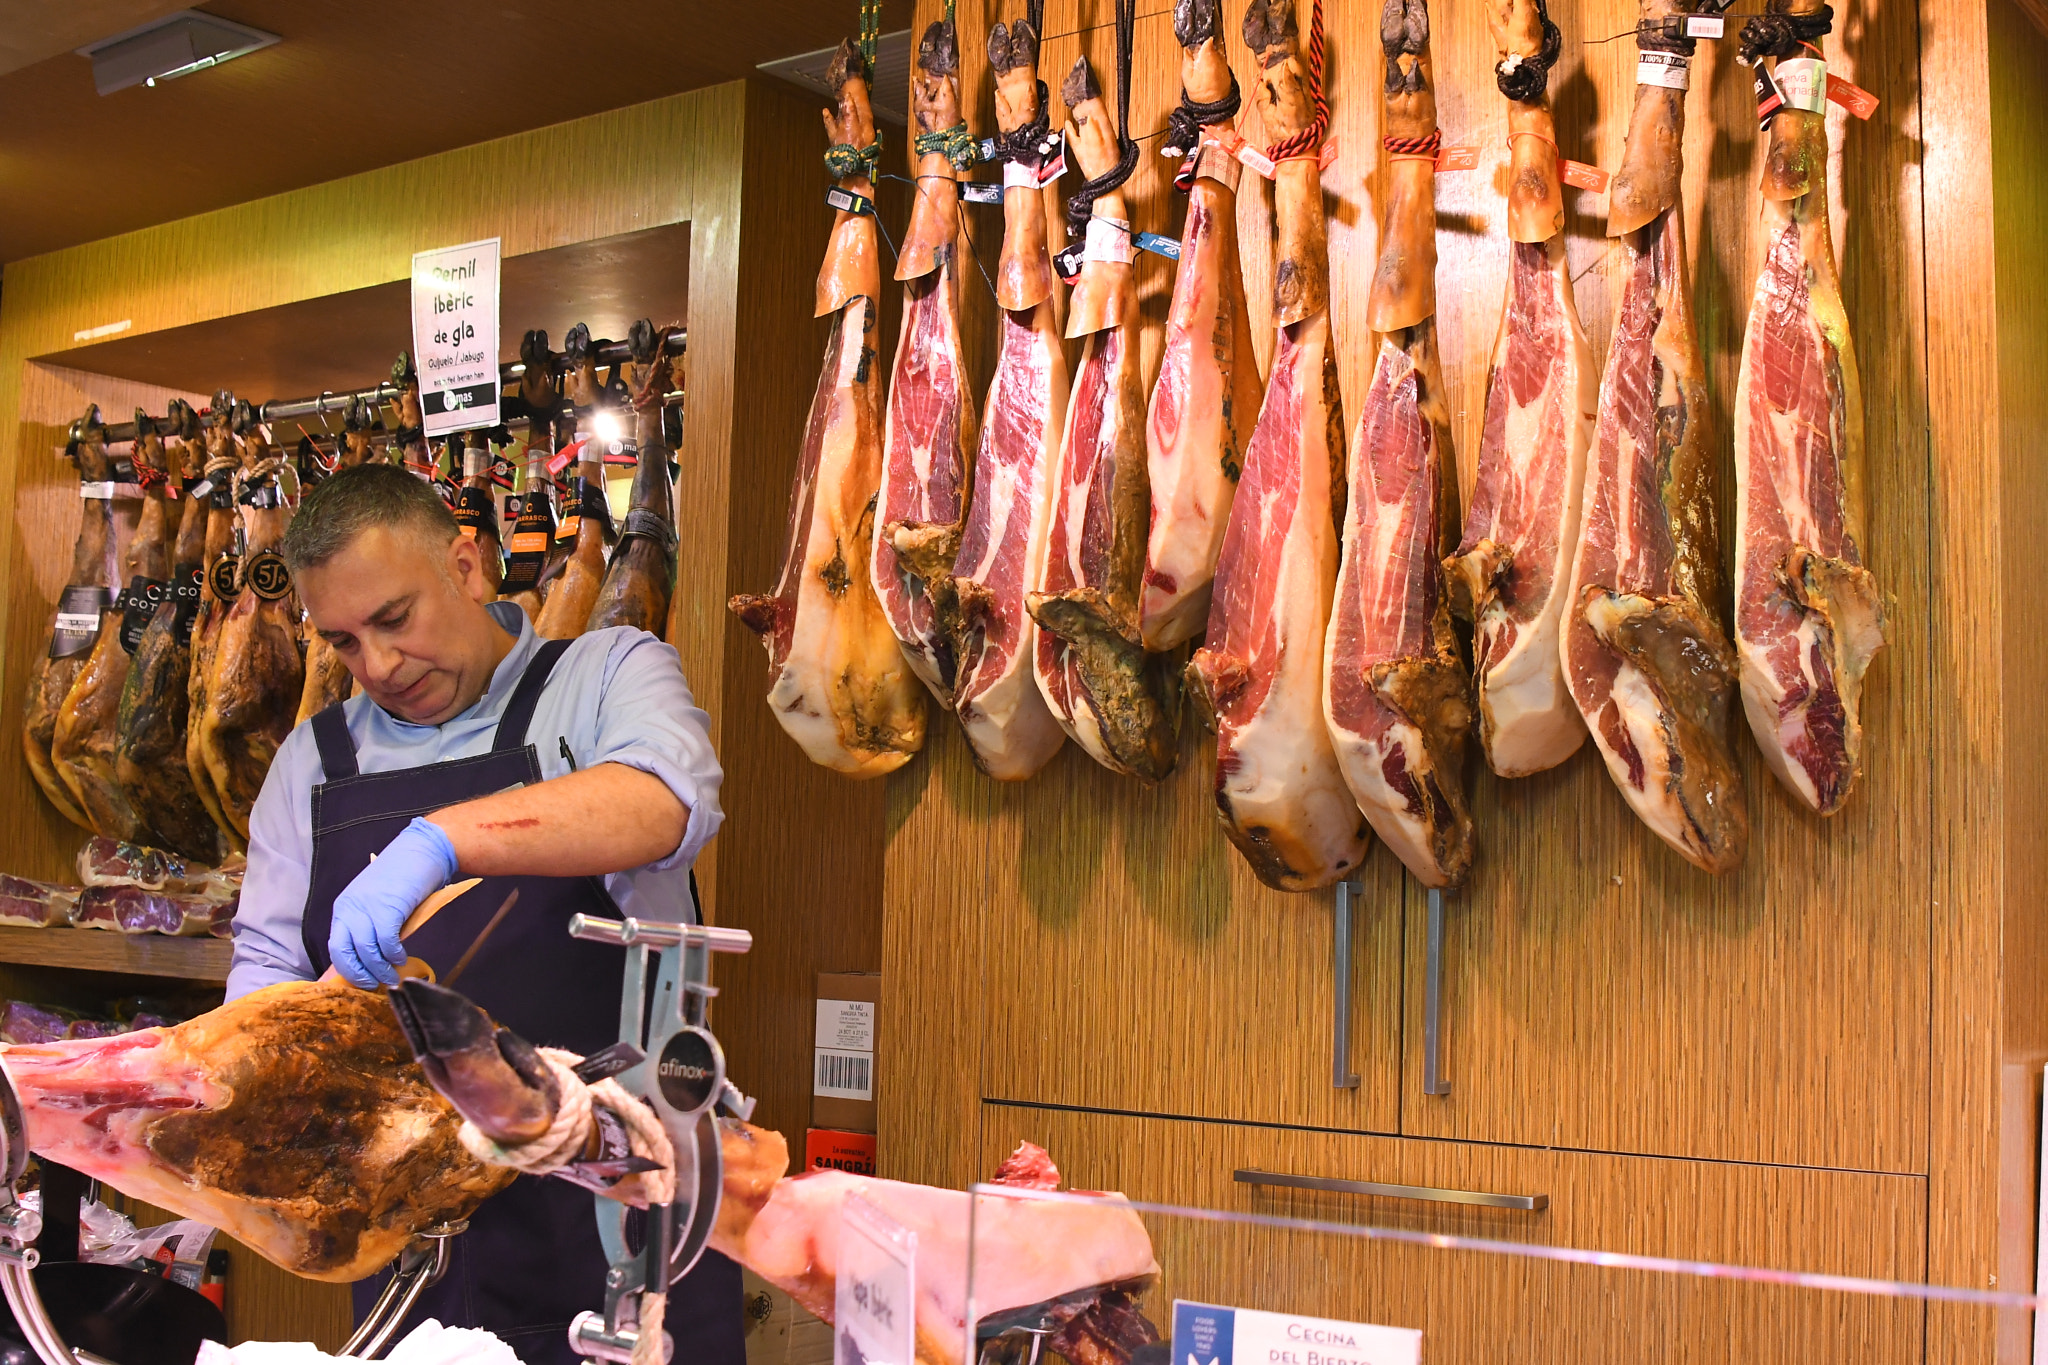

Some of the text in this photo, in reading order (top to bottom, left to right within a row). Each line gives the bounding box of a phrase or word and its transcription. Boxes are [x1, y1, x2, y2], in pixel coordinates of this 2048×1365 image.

[434, 292, 474, 314] ibèric
[434, 320, 474, 347] de gla
[258, 564, 281, 591] 5J
[129, 597, 158, 612] COT
[659, 1057, 704, 1080] afinox
